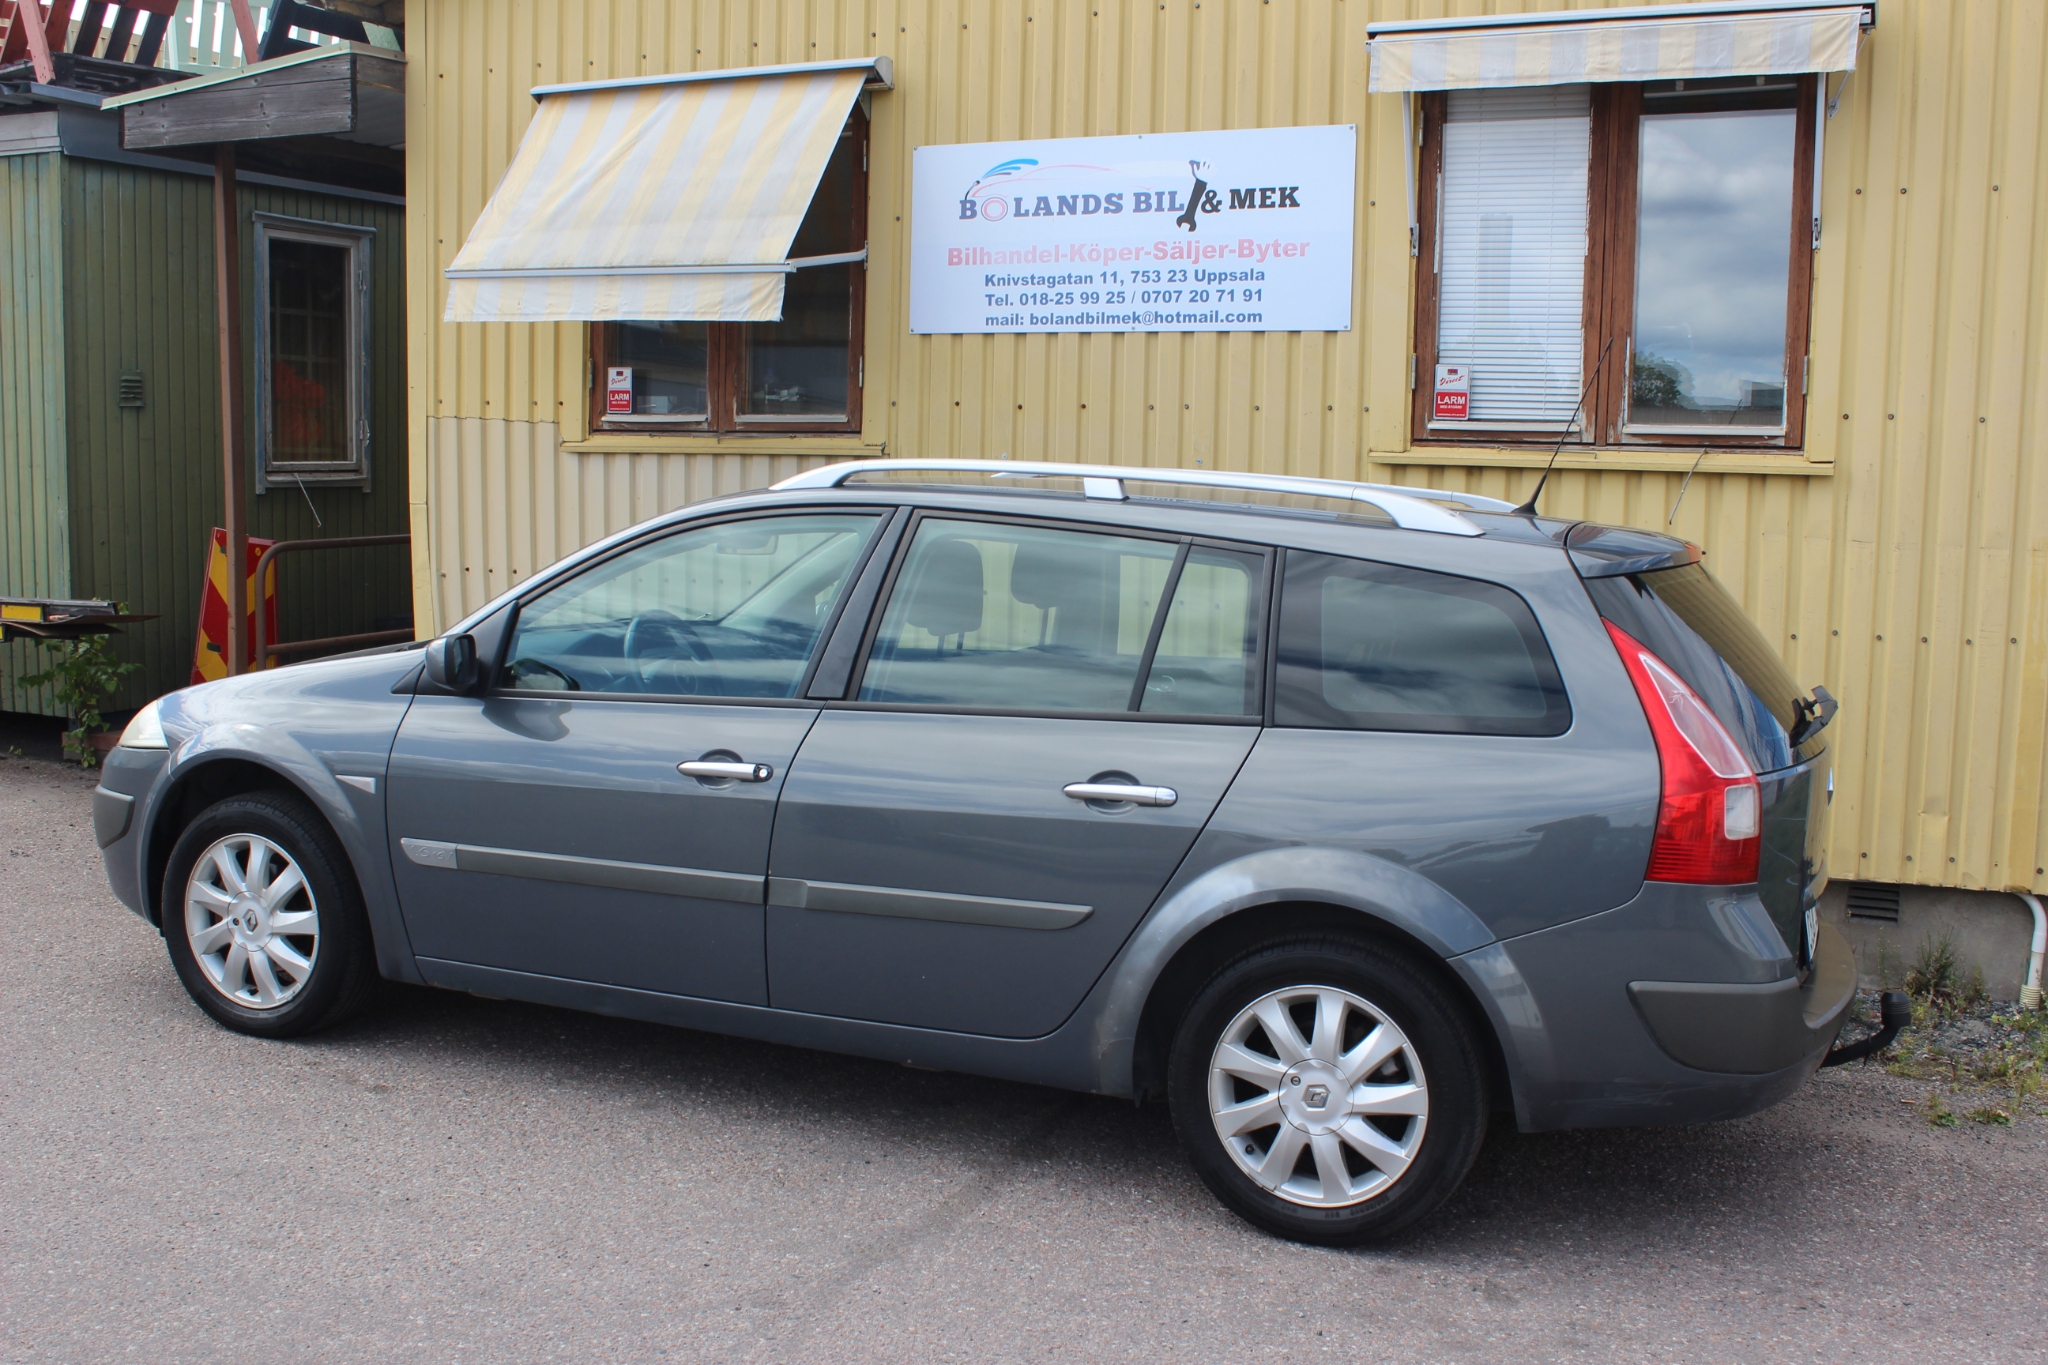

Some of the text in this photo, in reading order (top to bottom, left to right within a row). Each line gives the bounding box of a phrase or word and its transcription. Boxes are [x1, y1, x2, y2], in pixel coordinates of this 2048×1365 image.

[959, 186, 1301, 222] BOLANDS BIL & MEK
[947, 238, 1311, 267] Bilhandel-Köper-Säljer-Byter
[984, 268, 1266, 289] Knivstagatan 11, 753 23 Uppsala
[984, 288, 1263, 307] Tel. 018-25 99 25 / 0707 20 71 91
[985, 310, 1263, 326] mail: bolandbilmek@hotmail.com
[610, 393, 629, 401] LARM
[1437, 395, 1465, 404] LARM
